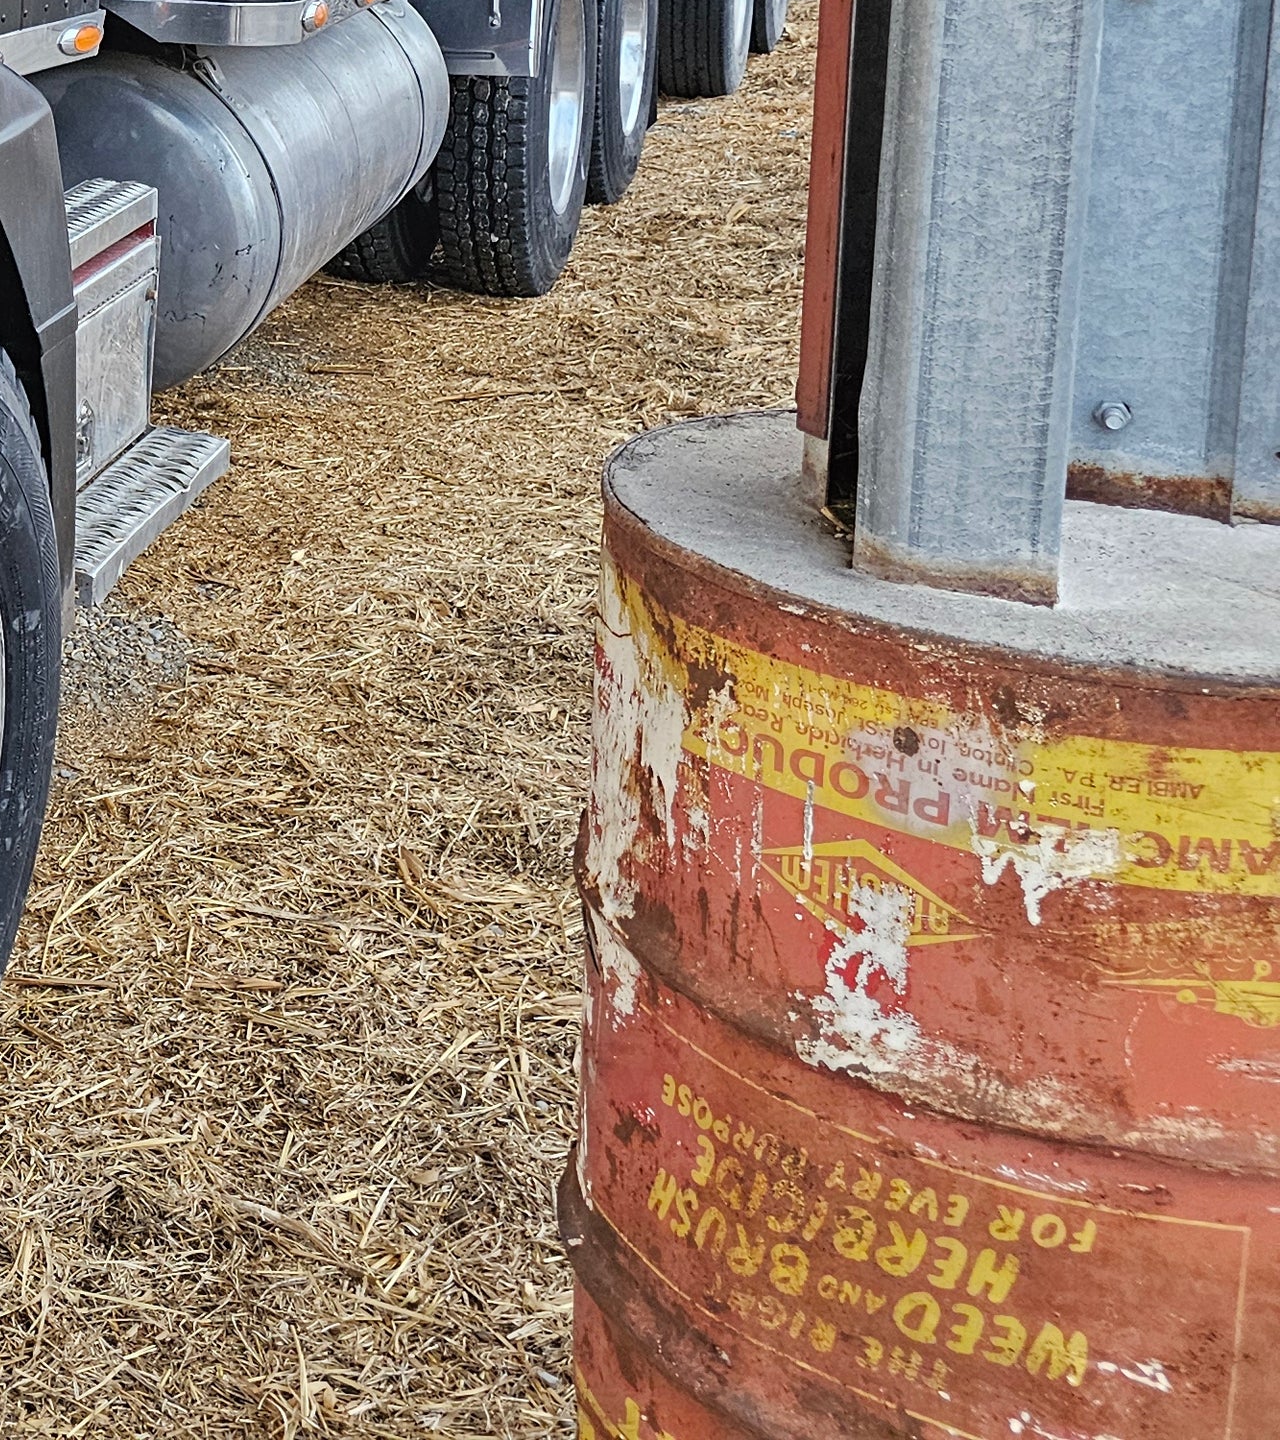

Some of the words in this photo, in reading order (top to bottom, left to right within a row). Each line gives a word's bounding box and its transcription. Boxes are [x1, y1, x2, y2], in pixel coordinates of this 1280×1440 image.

[952, 766, 1036, 806] Name
[1049, 790, 1106, 818] First
[661, 1073, 809, 1179] PURPOSE
[691, 1134, 1020, 1304] HERBICIDE
[824, 1160, 970, 1228] EVERY
[647, 1167, 810, 1297] BRUSH
[989, 1203, 1097, 1254] FOR
[817, 1274, 887, 1315] AND
[855, 1335, 950, 1389] THE
[893, 1291, 1089, 1387] WEED
